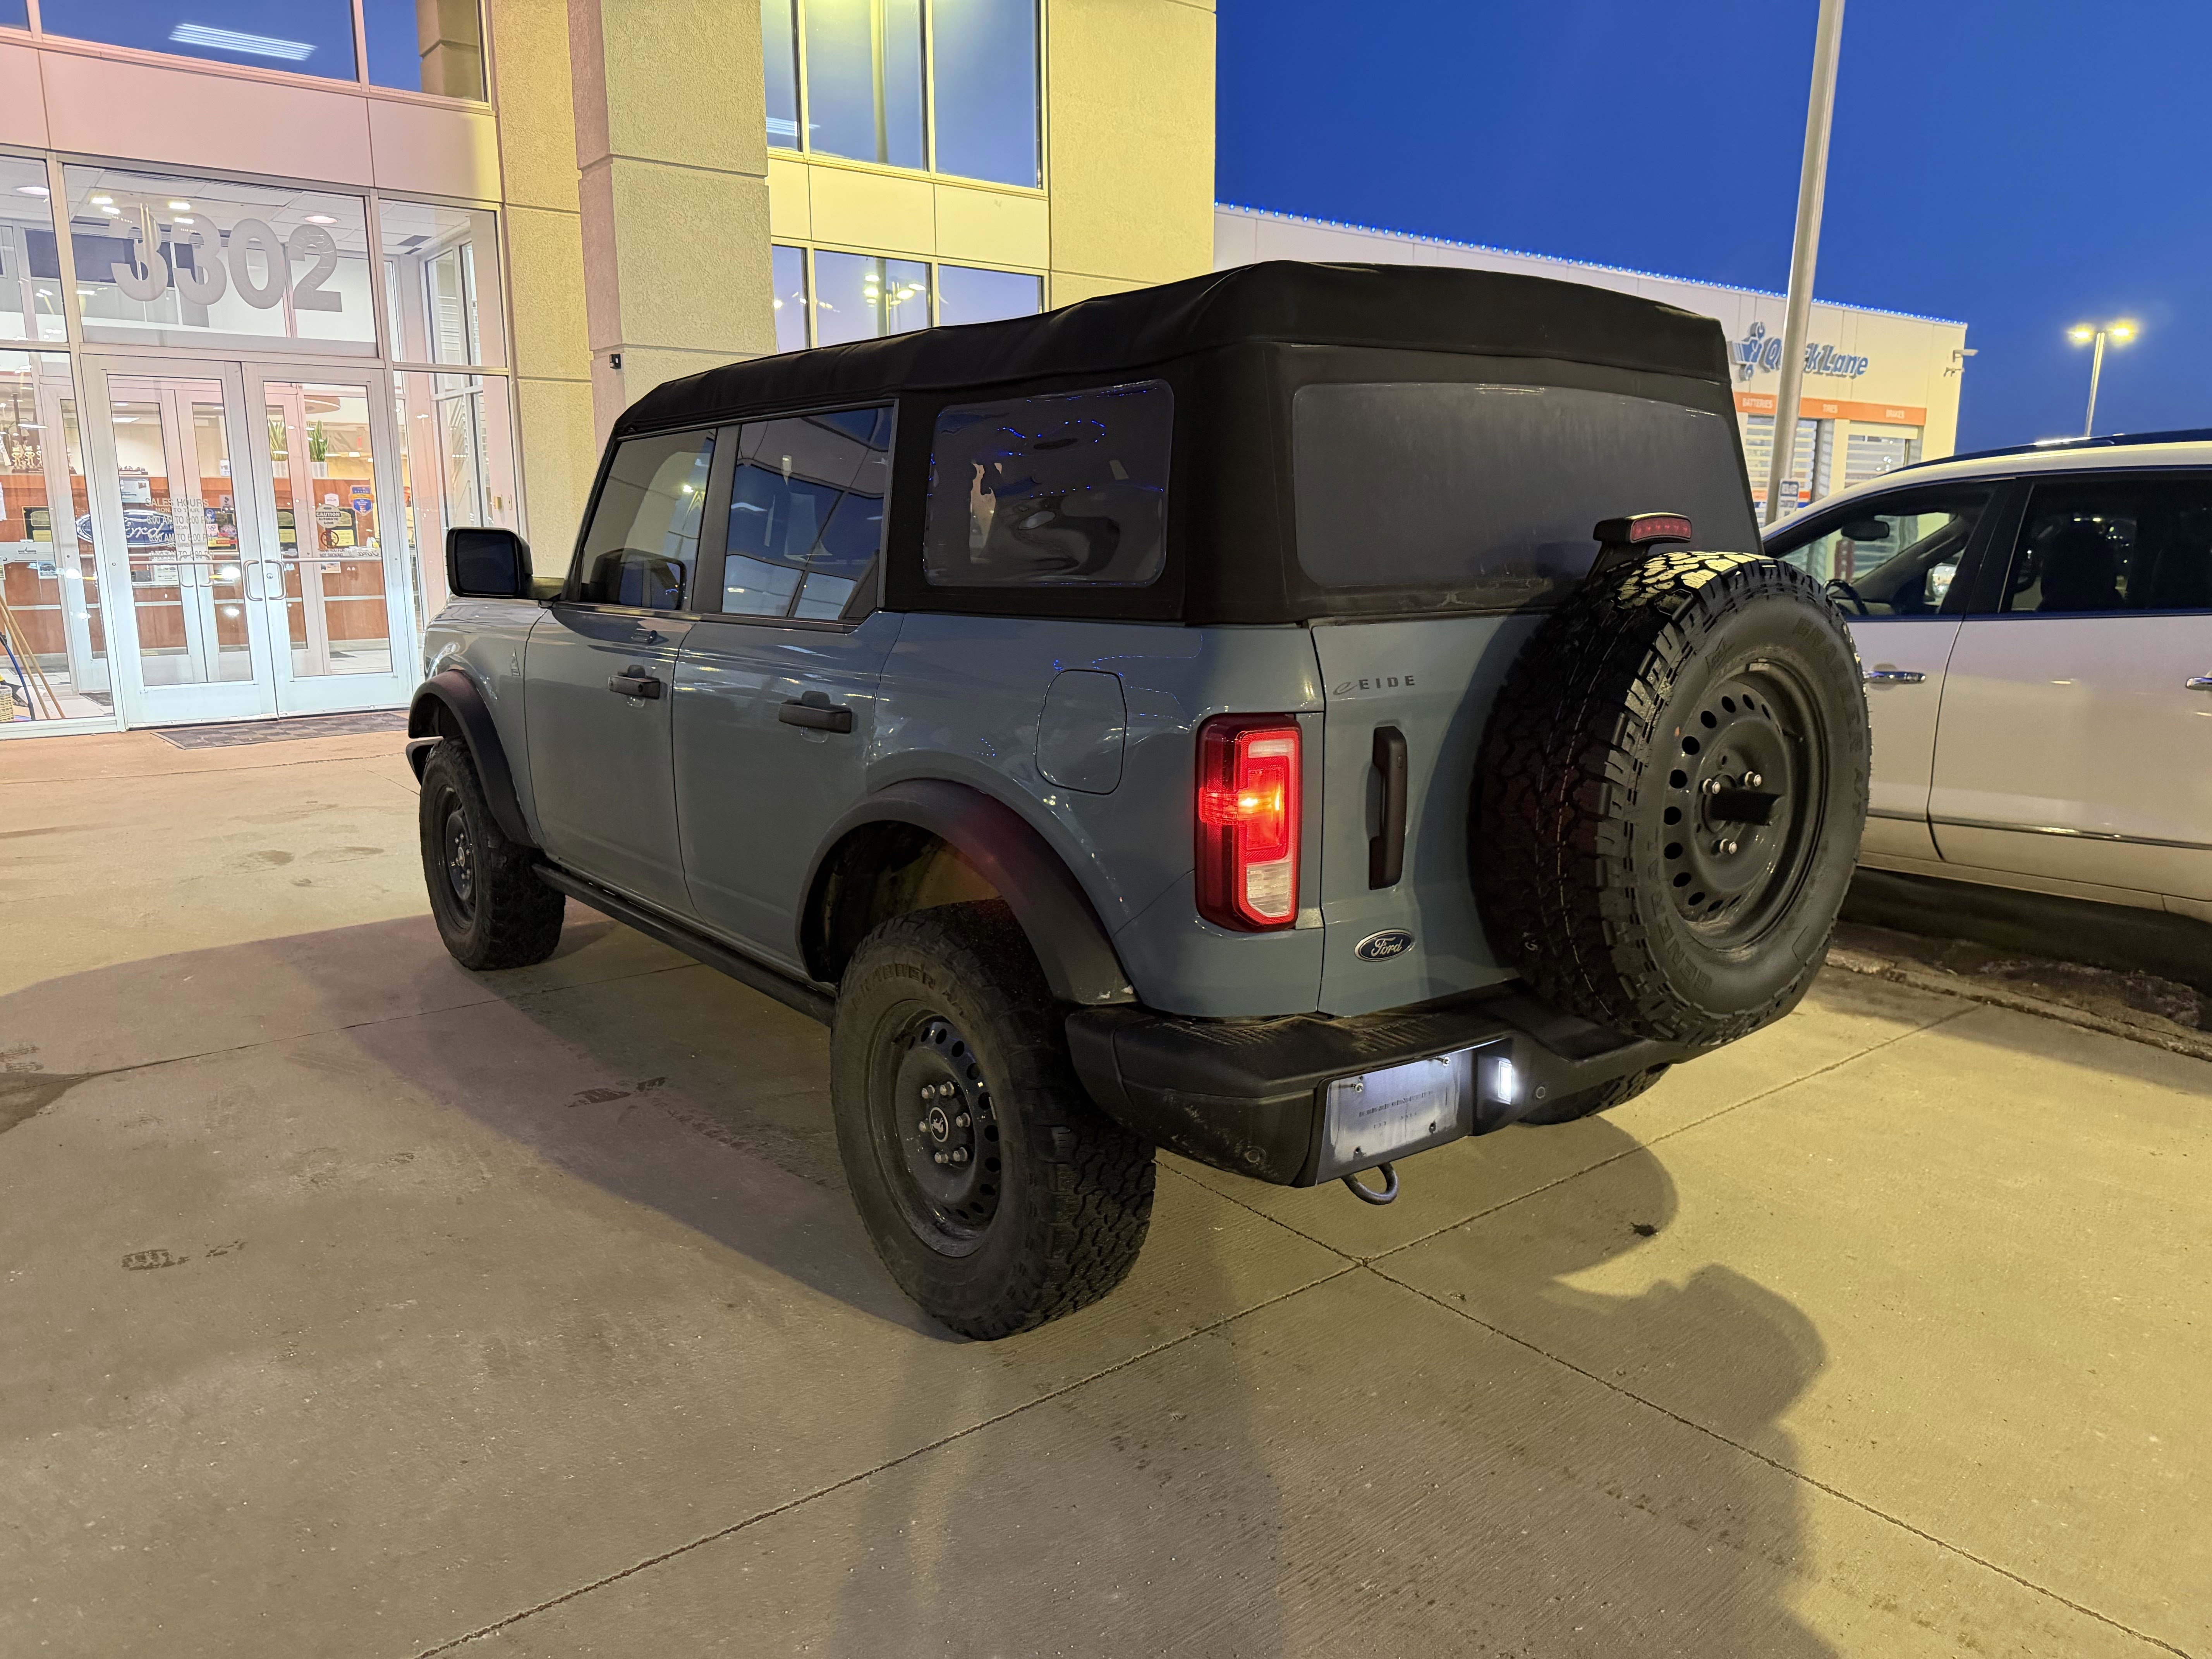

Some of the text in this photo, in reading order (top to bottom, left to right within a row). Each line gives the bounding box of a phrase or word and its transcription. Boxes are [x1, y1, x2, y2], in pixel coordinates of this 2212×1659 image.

[108, 206, 343, 312] 3302
[1820, 344, 1869, 376] Lane
[145, 498, 209, 508] SALES HOURS
[147, 516, 160, 524] 8:00
[163, 516, 173, 525] AM
[164, 533, 174, 542] AM
[1358, 675, 1415, 690] EIDE
[1370, 936, 1403, 957] Ford
